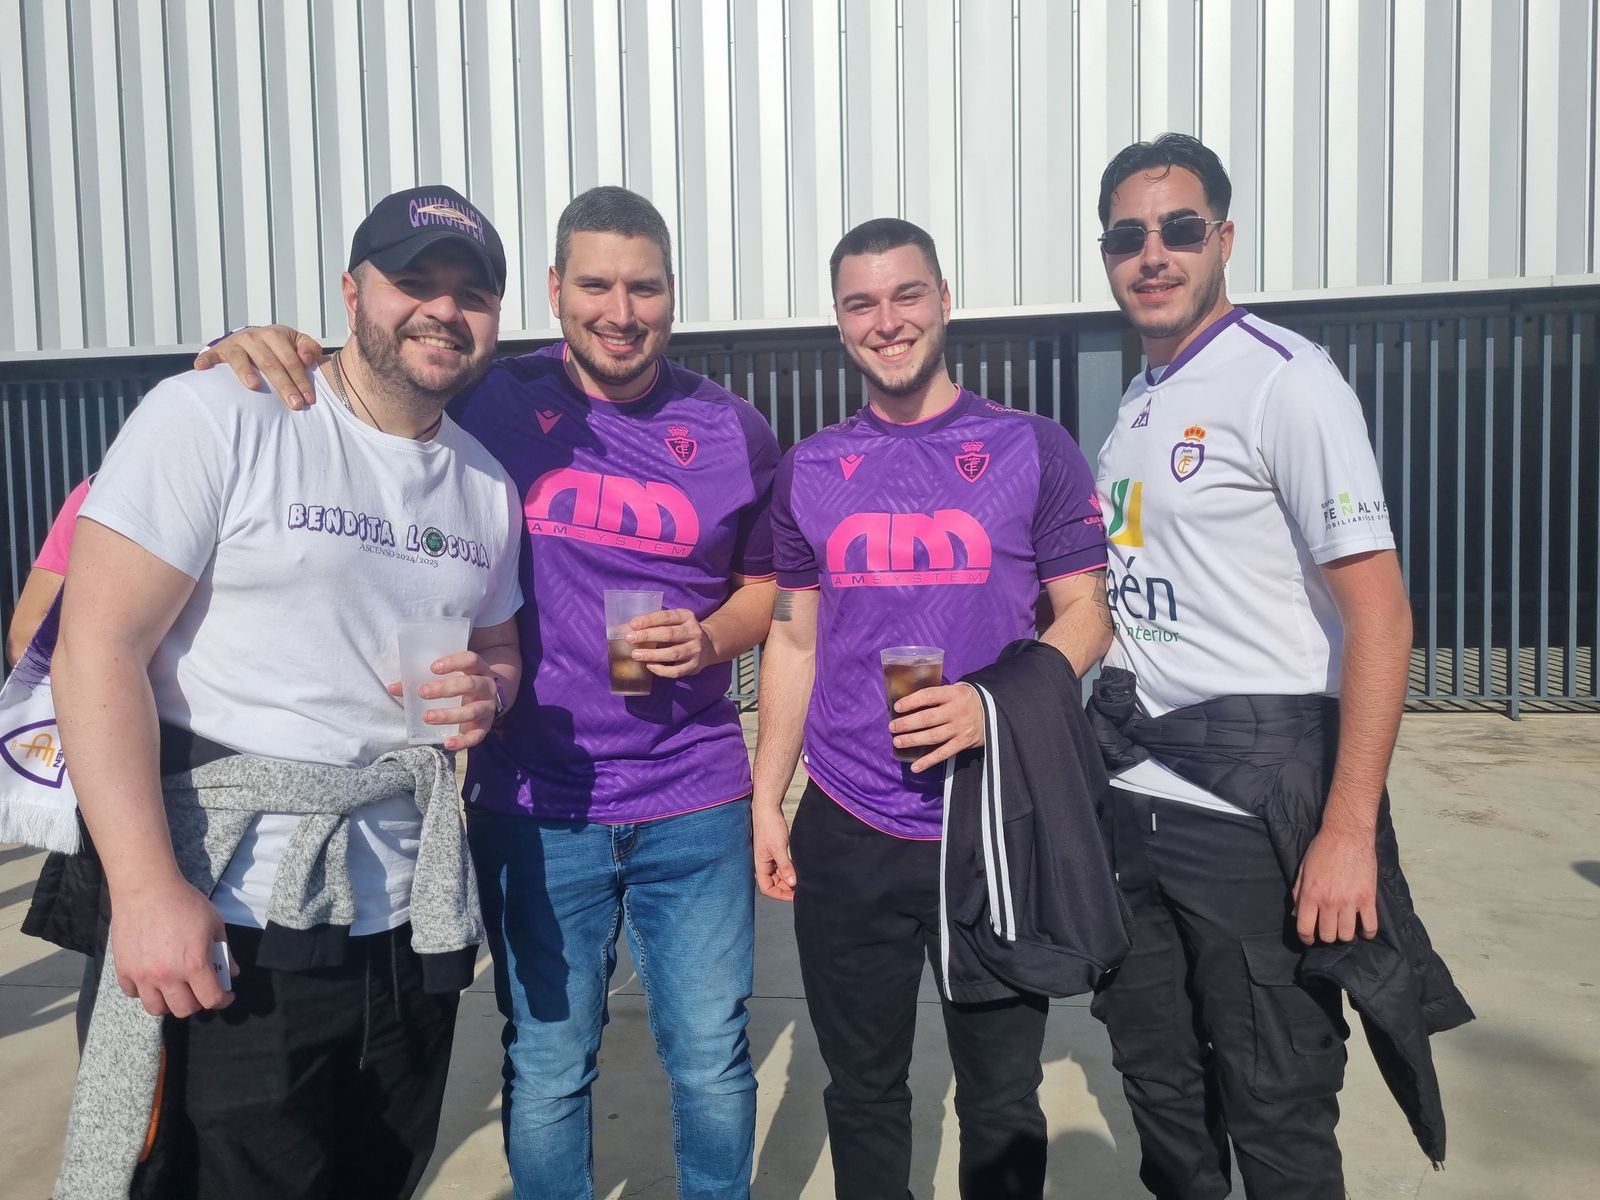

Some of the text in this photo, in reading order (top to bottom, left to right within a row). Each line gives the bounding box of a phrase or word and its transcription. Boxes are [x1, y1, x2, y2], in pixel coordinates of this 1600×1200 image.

[359, 543, 439, 568] ASCENSO 2024/2025
[406, 524, 490, 569] LOCURA
[1126, 625, 1179, 642] nterior
